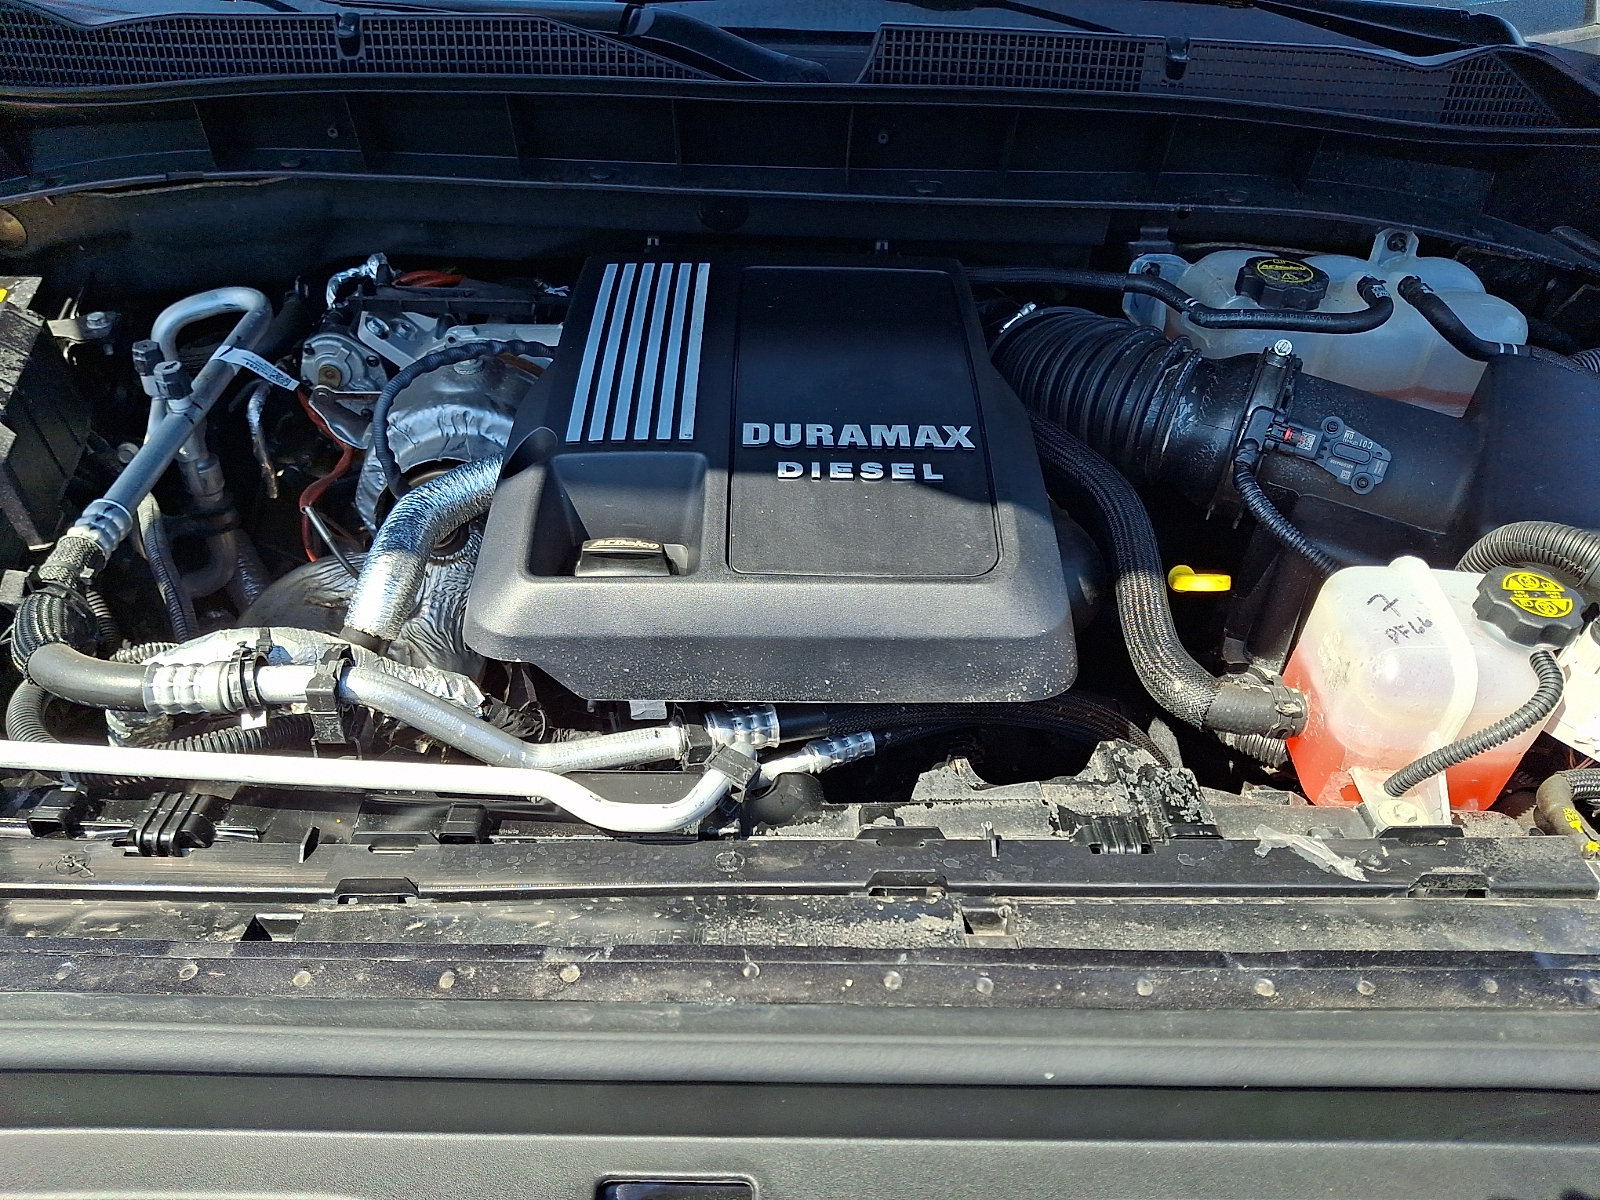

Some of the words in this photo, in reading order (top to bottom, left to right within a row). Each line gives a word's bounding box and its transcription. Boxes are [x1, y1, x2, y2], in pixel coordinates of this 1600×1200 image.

[742, 422, 976, 449] DURAMAX
[777, 461, 944, 482] DIESEL
[588, 539, 660, 550] ACDelco
